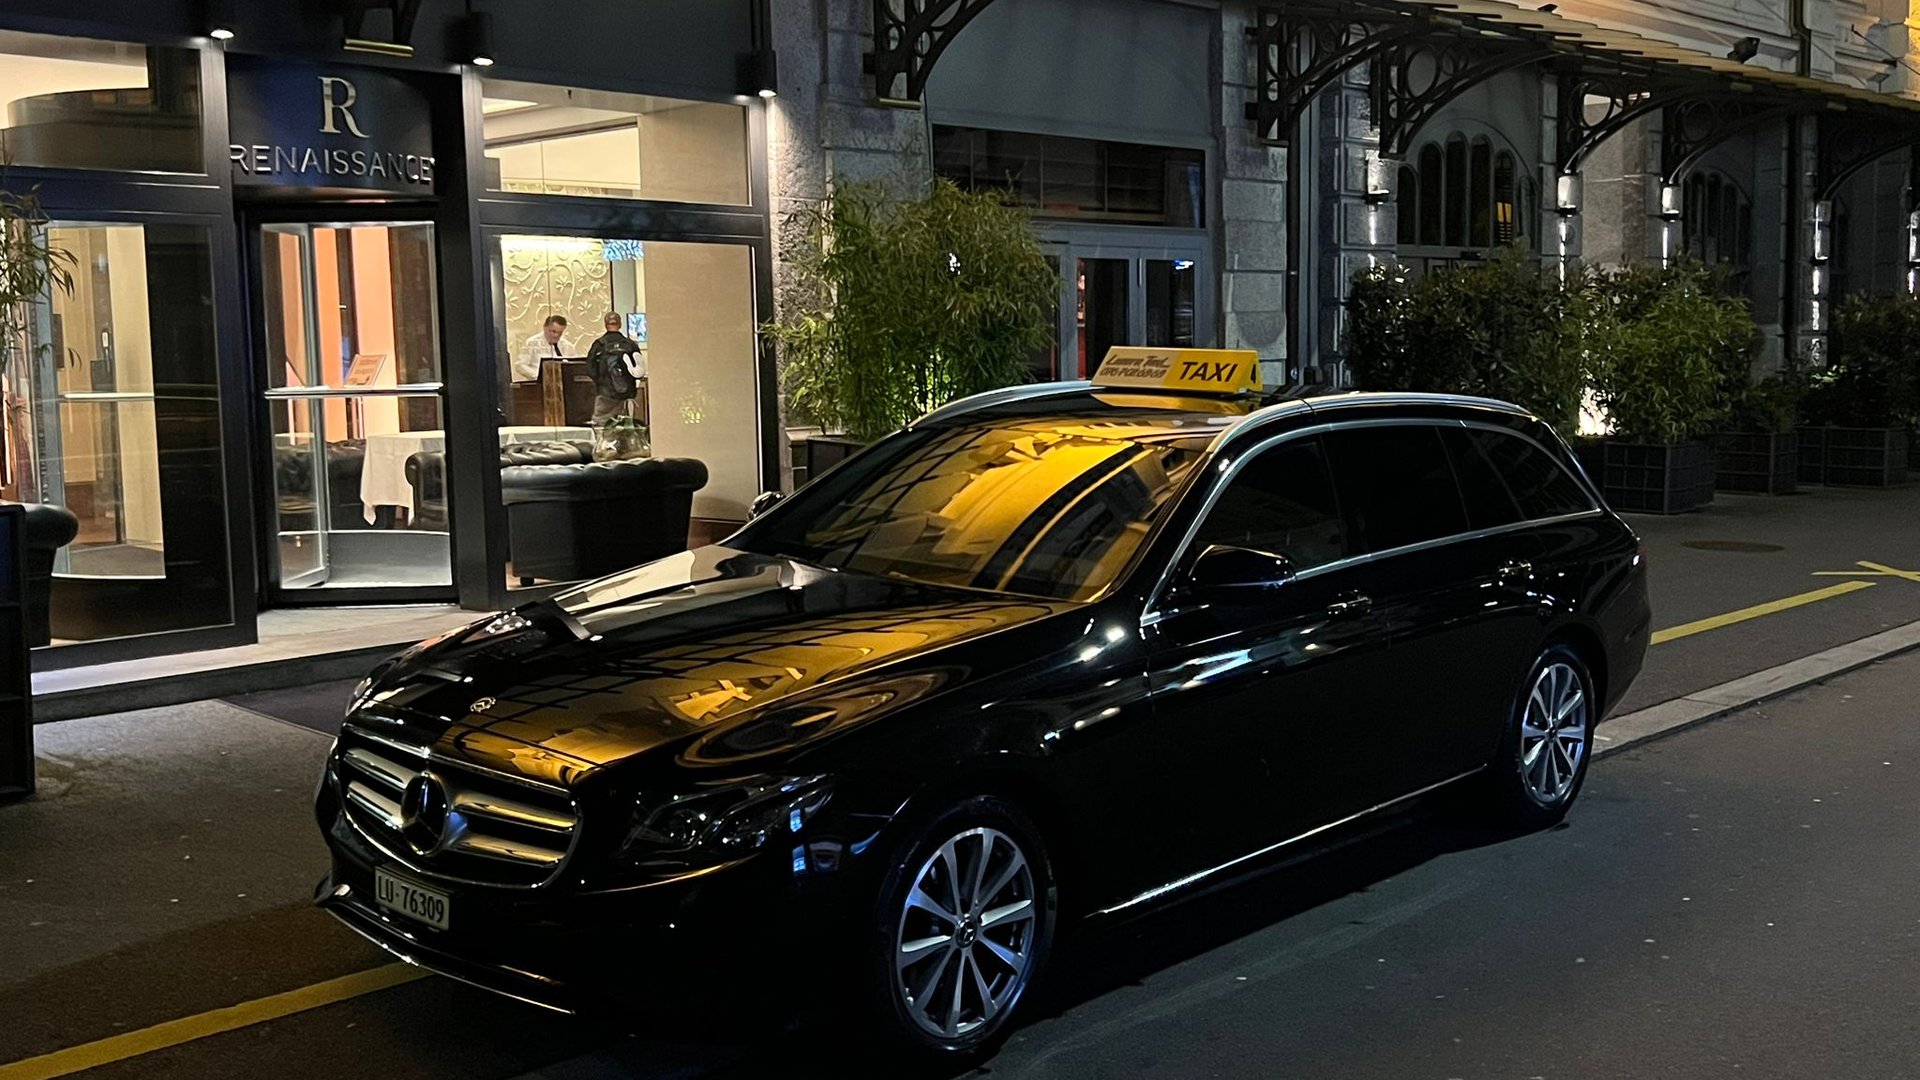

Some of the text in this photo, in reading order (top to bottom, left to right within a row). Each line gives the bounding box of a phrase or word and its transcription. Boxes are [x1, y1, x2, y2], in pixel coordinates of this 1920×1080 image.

[318, 76, 370, 138] R
[230, 145, 433, 181] RENAISSANCE
[1180, 361, 1238, 382] TAXI
